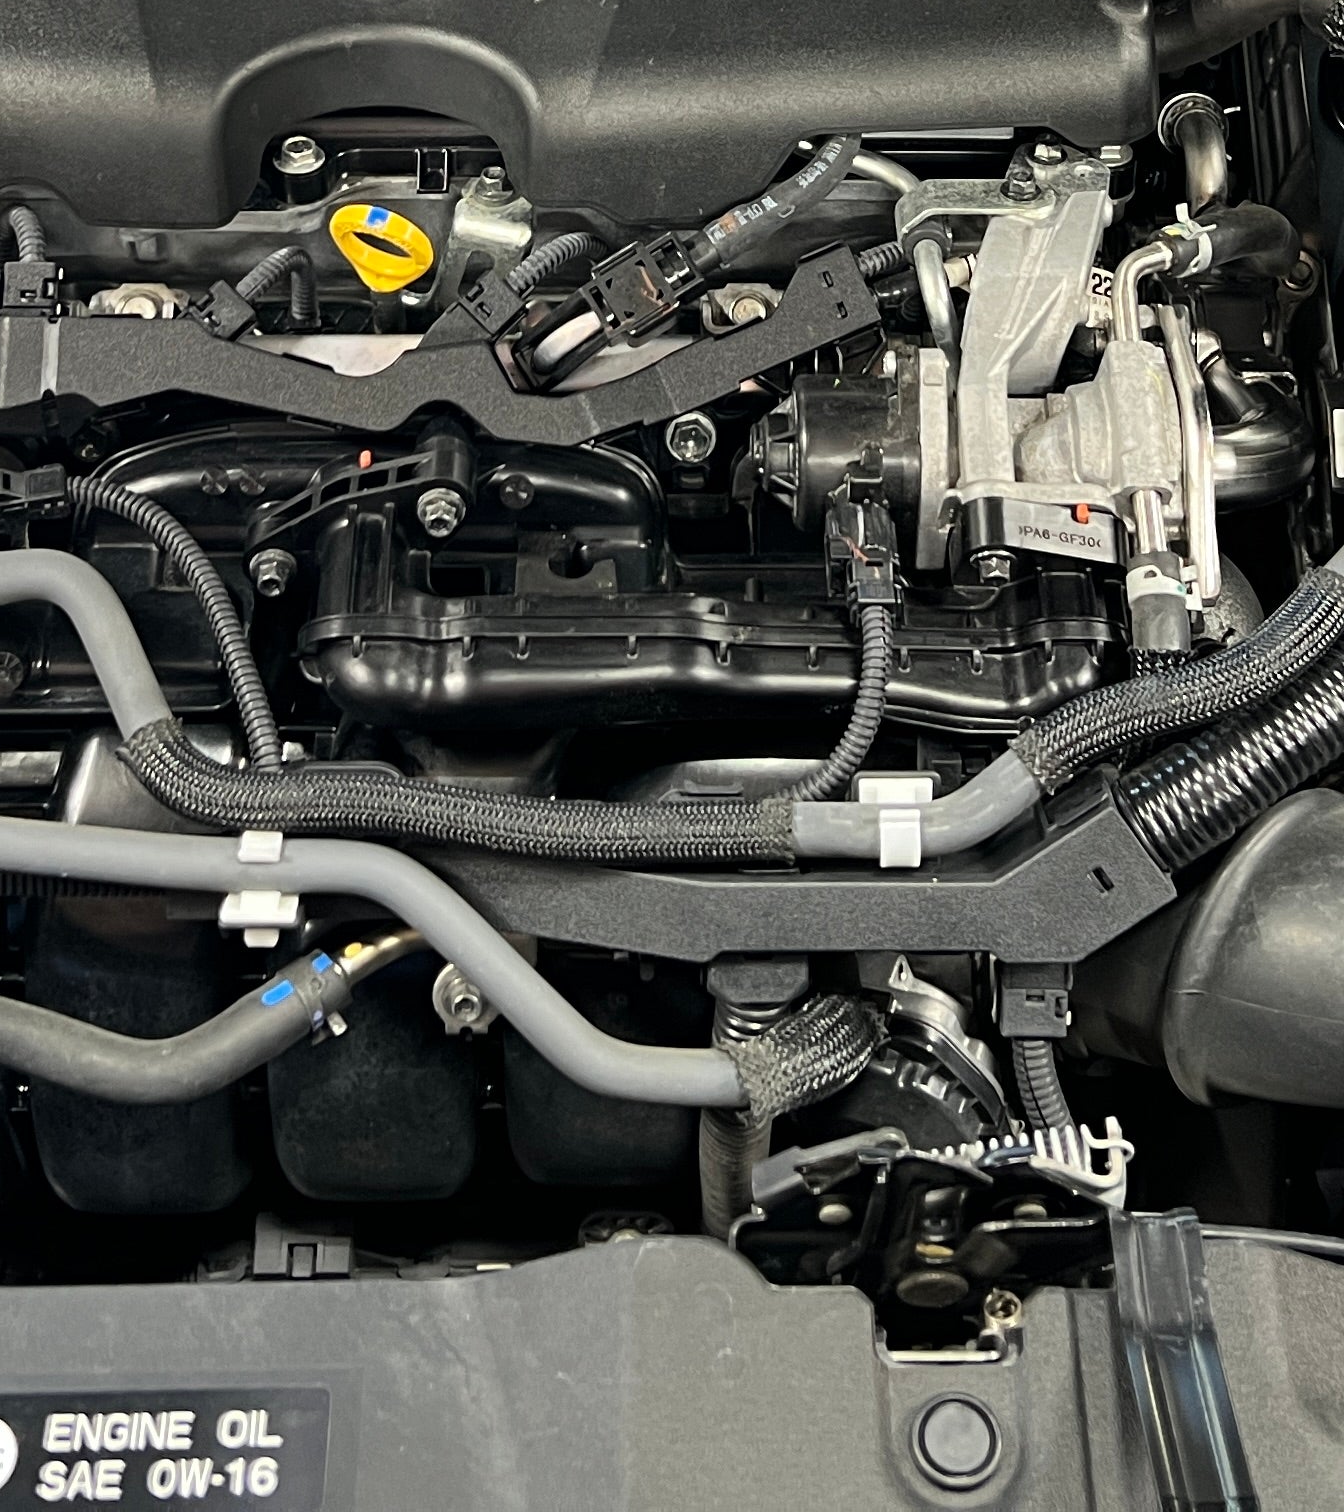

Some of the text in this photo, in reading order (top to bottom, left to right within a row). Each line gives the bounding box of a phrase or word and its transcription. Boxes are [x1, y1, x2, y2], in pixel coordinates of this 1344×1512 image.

[42, 1409, 283, 1452] ENGINE OIL
[35, 1456, 280, 1501] SAE 0W-16
